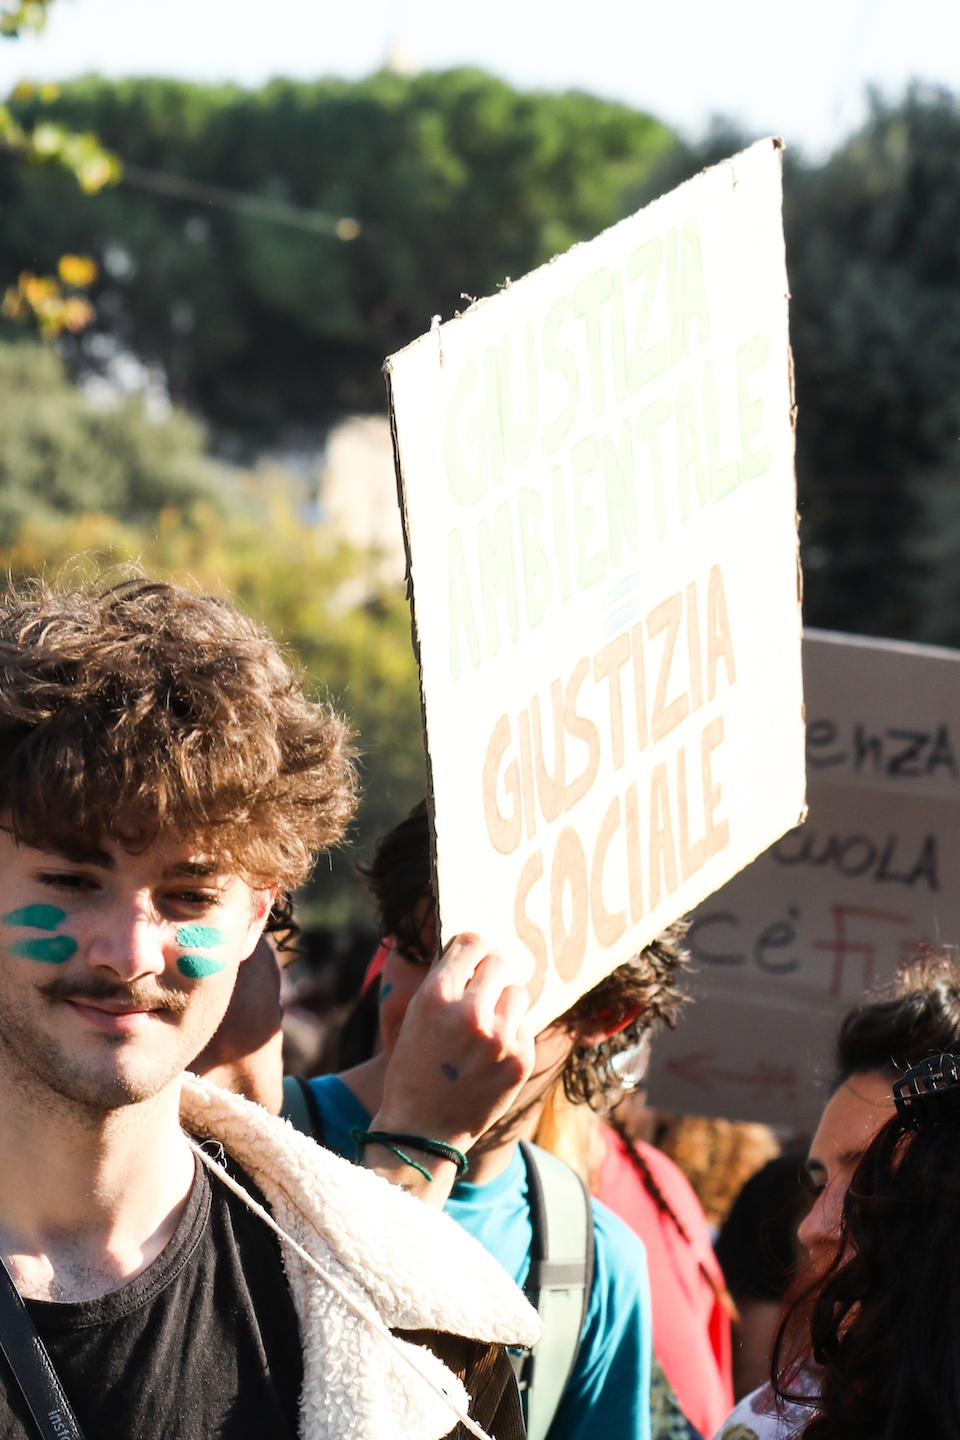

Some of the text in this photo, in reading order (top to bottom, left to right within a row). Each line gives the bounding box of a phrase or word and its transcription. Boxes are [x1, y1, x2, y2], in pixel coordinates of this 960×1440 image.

[443, 215, 711, 507] GIUSTIZIA
[447, 334, 772, 684] AMBIENTALE
[482, 563, 737, 855] GIUSTIZIA
[514, 714, 730, 1014] SOCIALE
